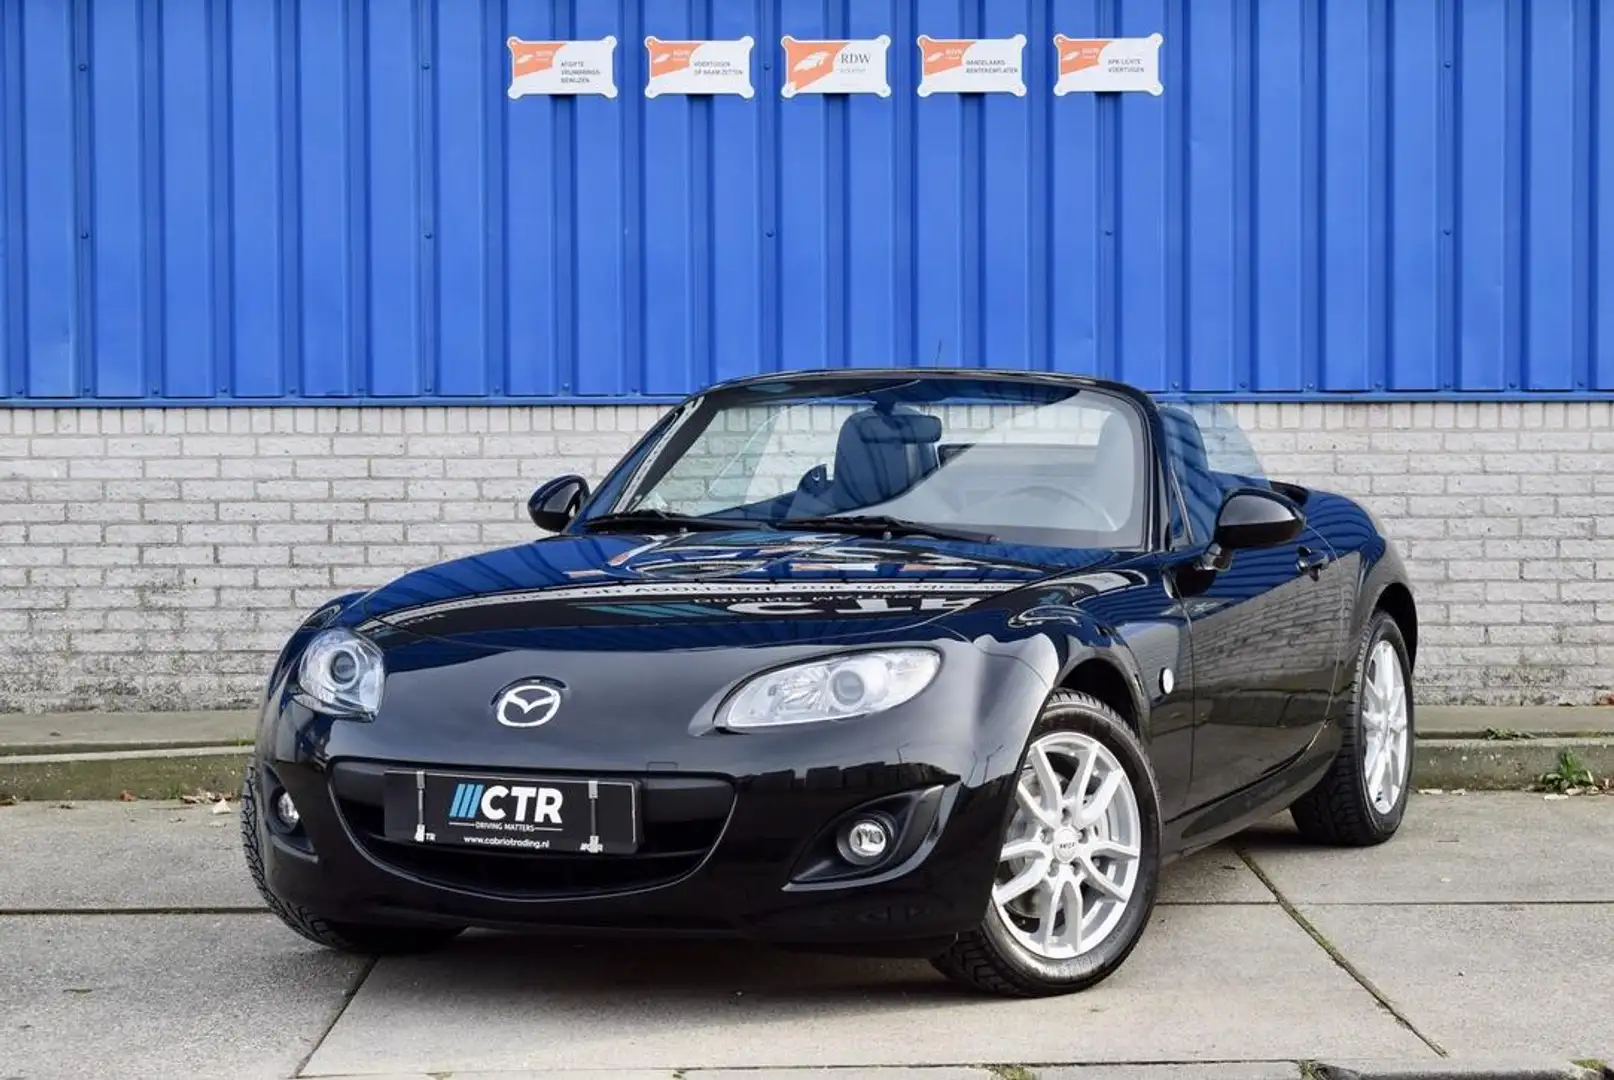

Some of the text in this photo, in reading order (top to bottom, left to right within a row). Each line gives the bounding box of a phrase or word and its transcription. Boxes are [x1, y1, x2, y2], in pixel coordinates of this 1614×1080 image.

[841, 53, 871, 64] RDW
[481, 785, 563, 824] CTR
[476, 821, 535, 832] DRIVING MATTERS
[463, 836, 550, 849] www.cabriotrading.nl
